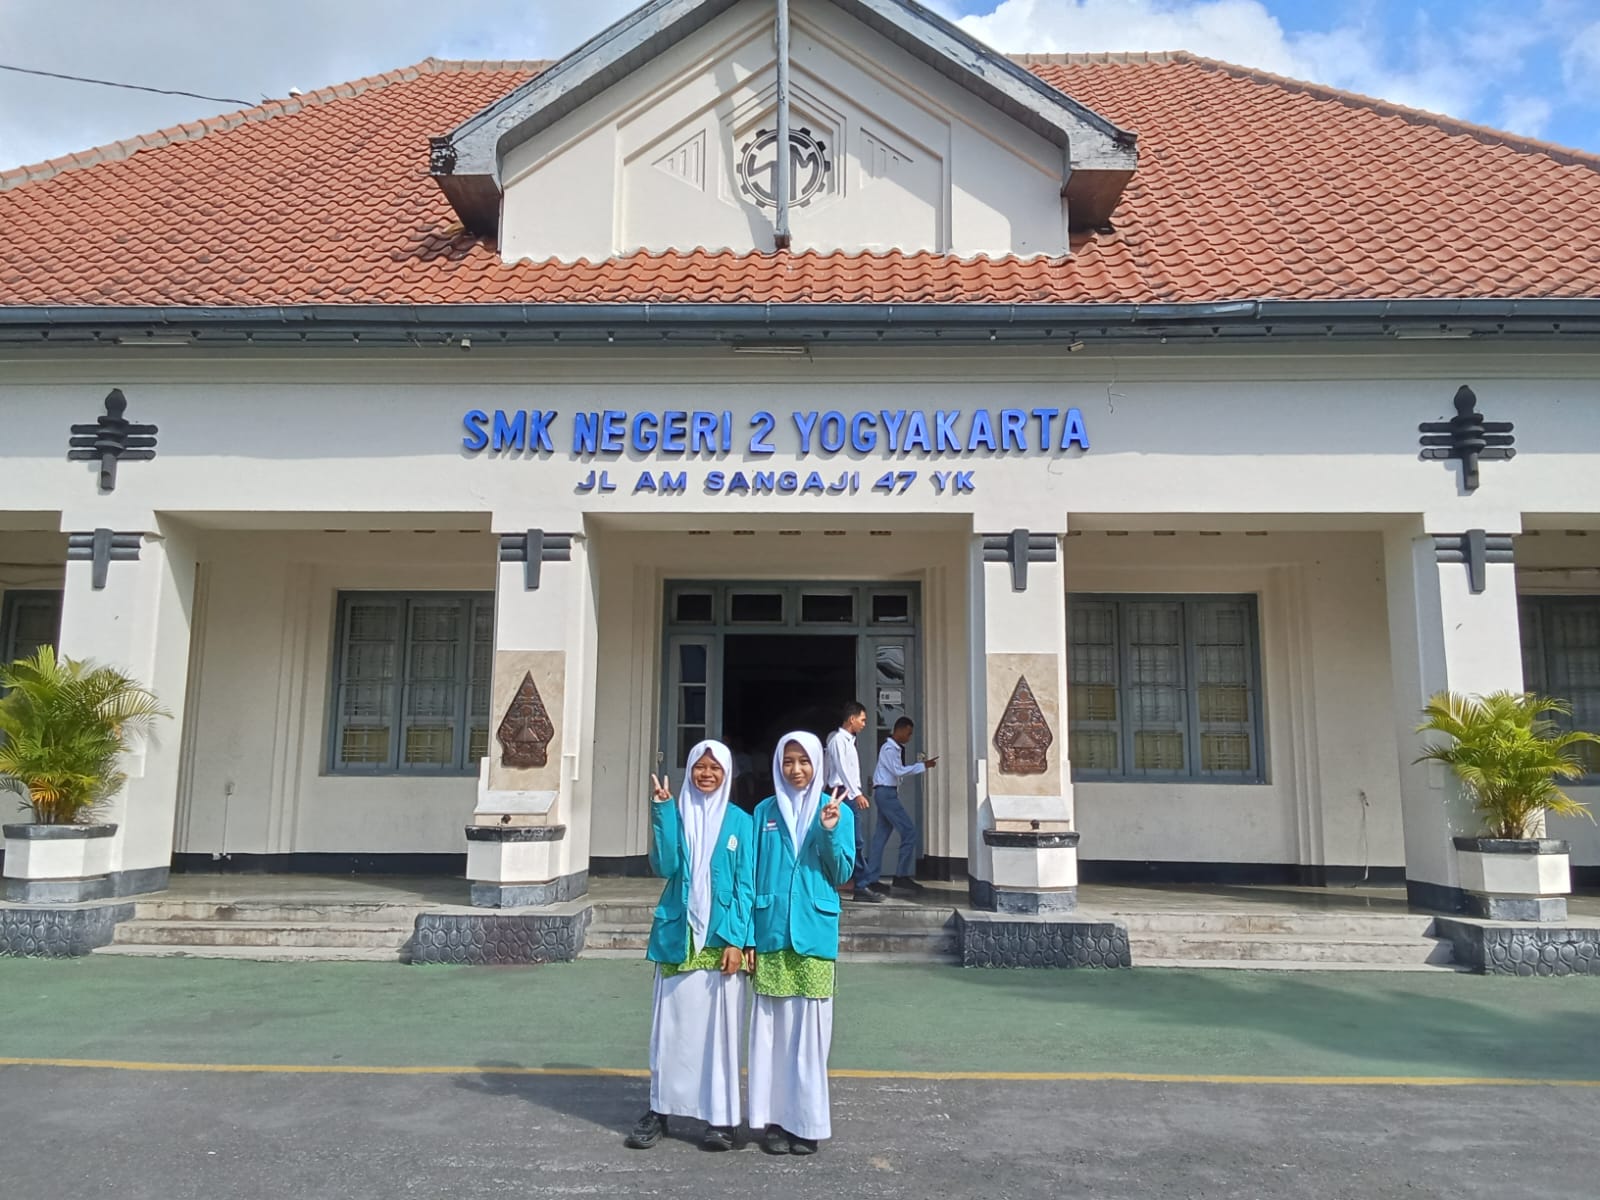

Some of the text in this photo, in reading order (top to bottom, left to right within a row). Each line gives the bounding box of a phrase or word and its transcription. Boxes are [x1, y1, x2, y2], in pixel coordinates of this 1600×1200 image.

[462, 407, 1091, 454] SMK NEGERI 2 YOGYAKARTA
[577, 470, 976, 491] JL AM SANGAJI 47 YK
